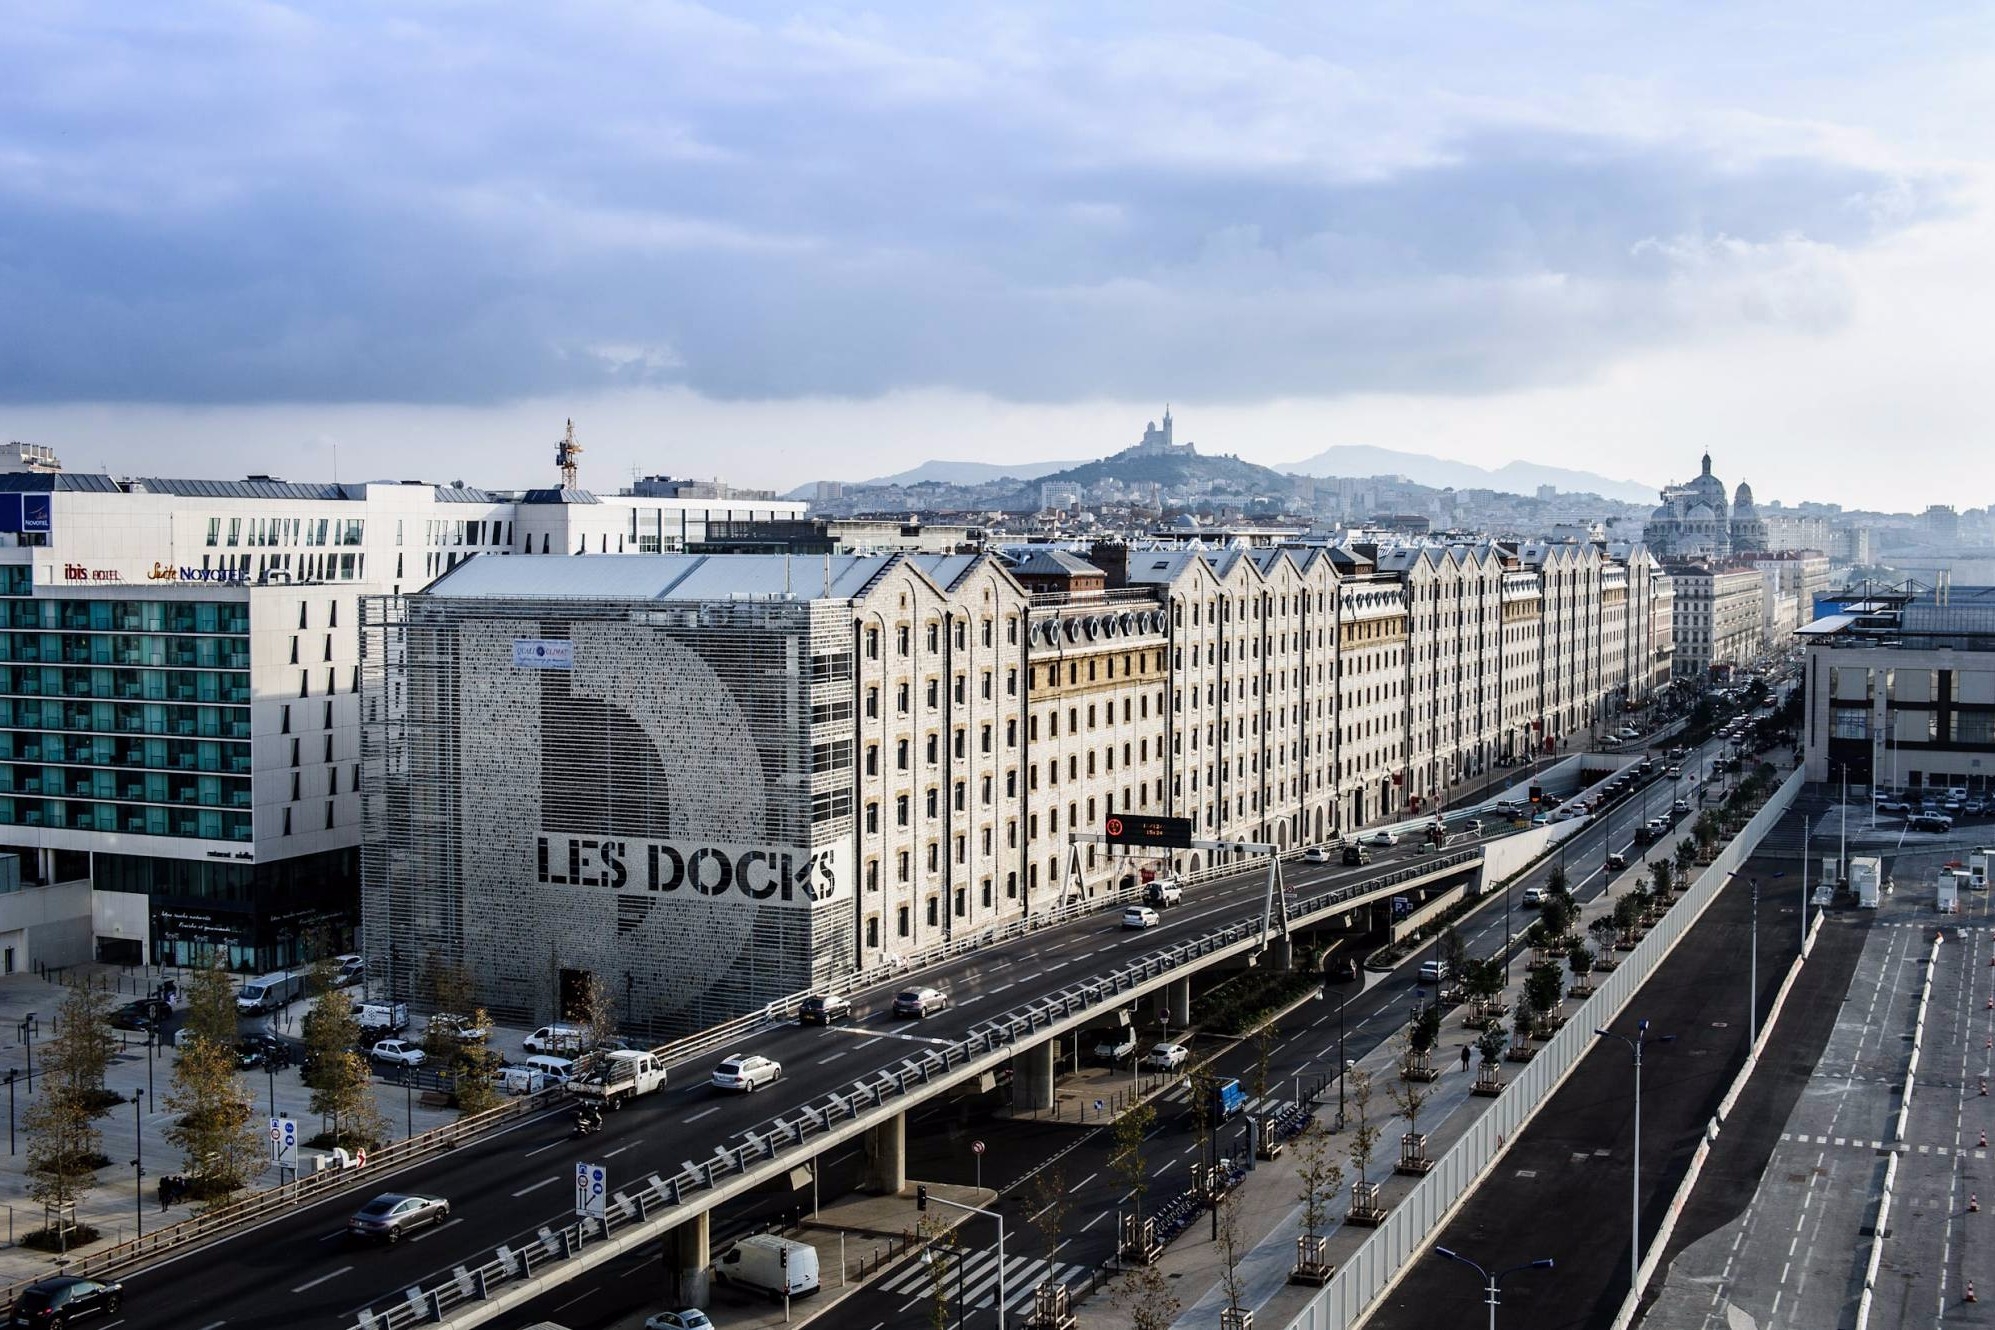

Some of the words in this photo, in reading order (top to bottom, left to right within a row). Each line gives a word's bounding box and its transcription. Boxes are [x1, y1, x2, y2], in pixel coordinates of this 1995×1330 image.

[65, 563, 87, 580] ibis
[148, 562, 177, 580] Suite
[180, 566, 247, 582] NOVOTEL
[537, 837, 628, 889] LES
[647, 844, 836, 903] DOCKS
